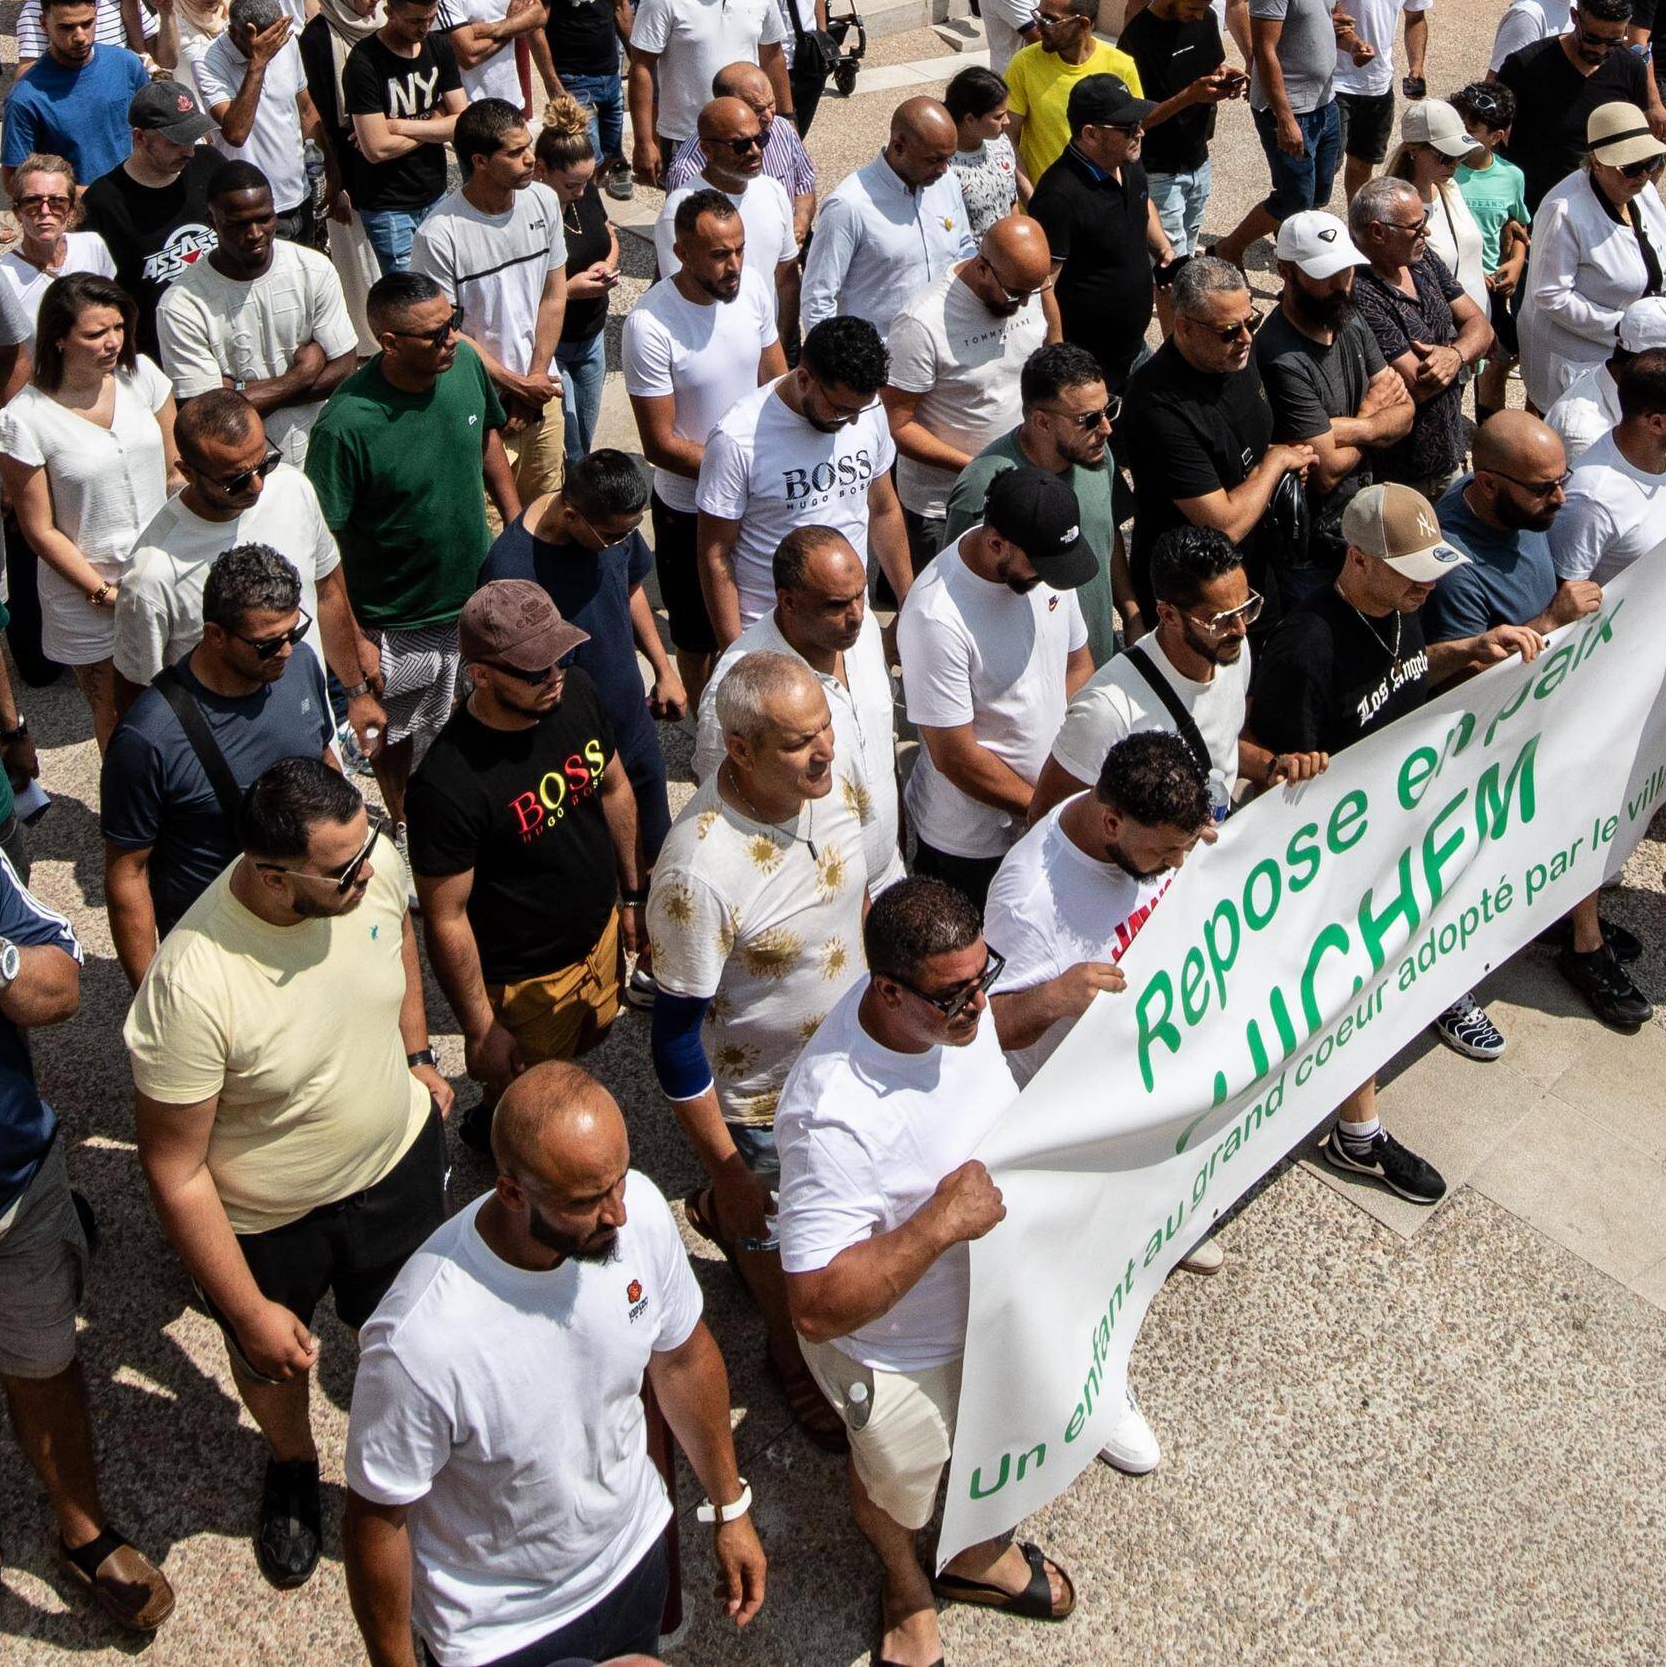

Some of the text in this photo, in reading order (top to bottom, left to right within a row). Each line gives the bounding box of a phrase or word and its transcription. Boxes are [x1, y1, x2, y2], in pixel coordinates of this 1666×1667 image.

[782, 449, 873, 501] BOSS
[787, 494, 829, 510] HUGO
[508, 739, 605, 835] BOSS
[1136, 598, 1625, 1093] Repose en paix
[969, 1443, 1046, 1500] Un
[1064, 1258, 1136, 1444] enfant
[1143, 1200, 1184, 1269] au
[1191, 1071, 1286, 1213] grand
[1295, 978, 1389, 1087] coeur
[1398, 874, 1513, 992] adopté
[1525, 837, 1584, 907] par
[1591, 815, 1619, 851] le
